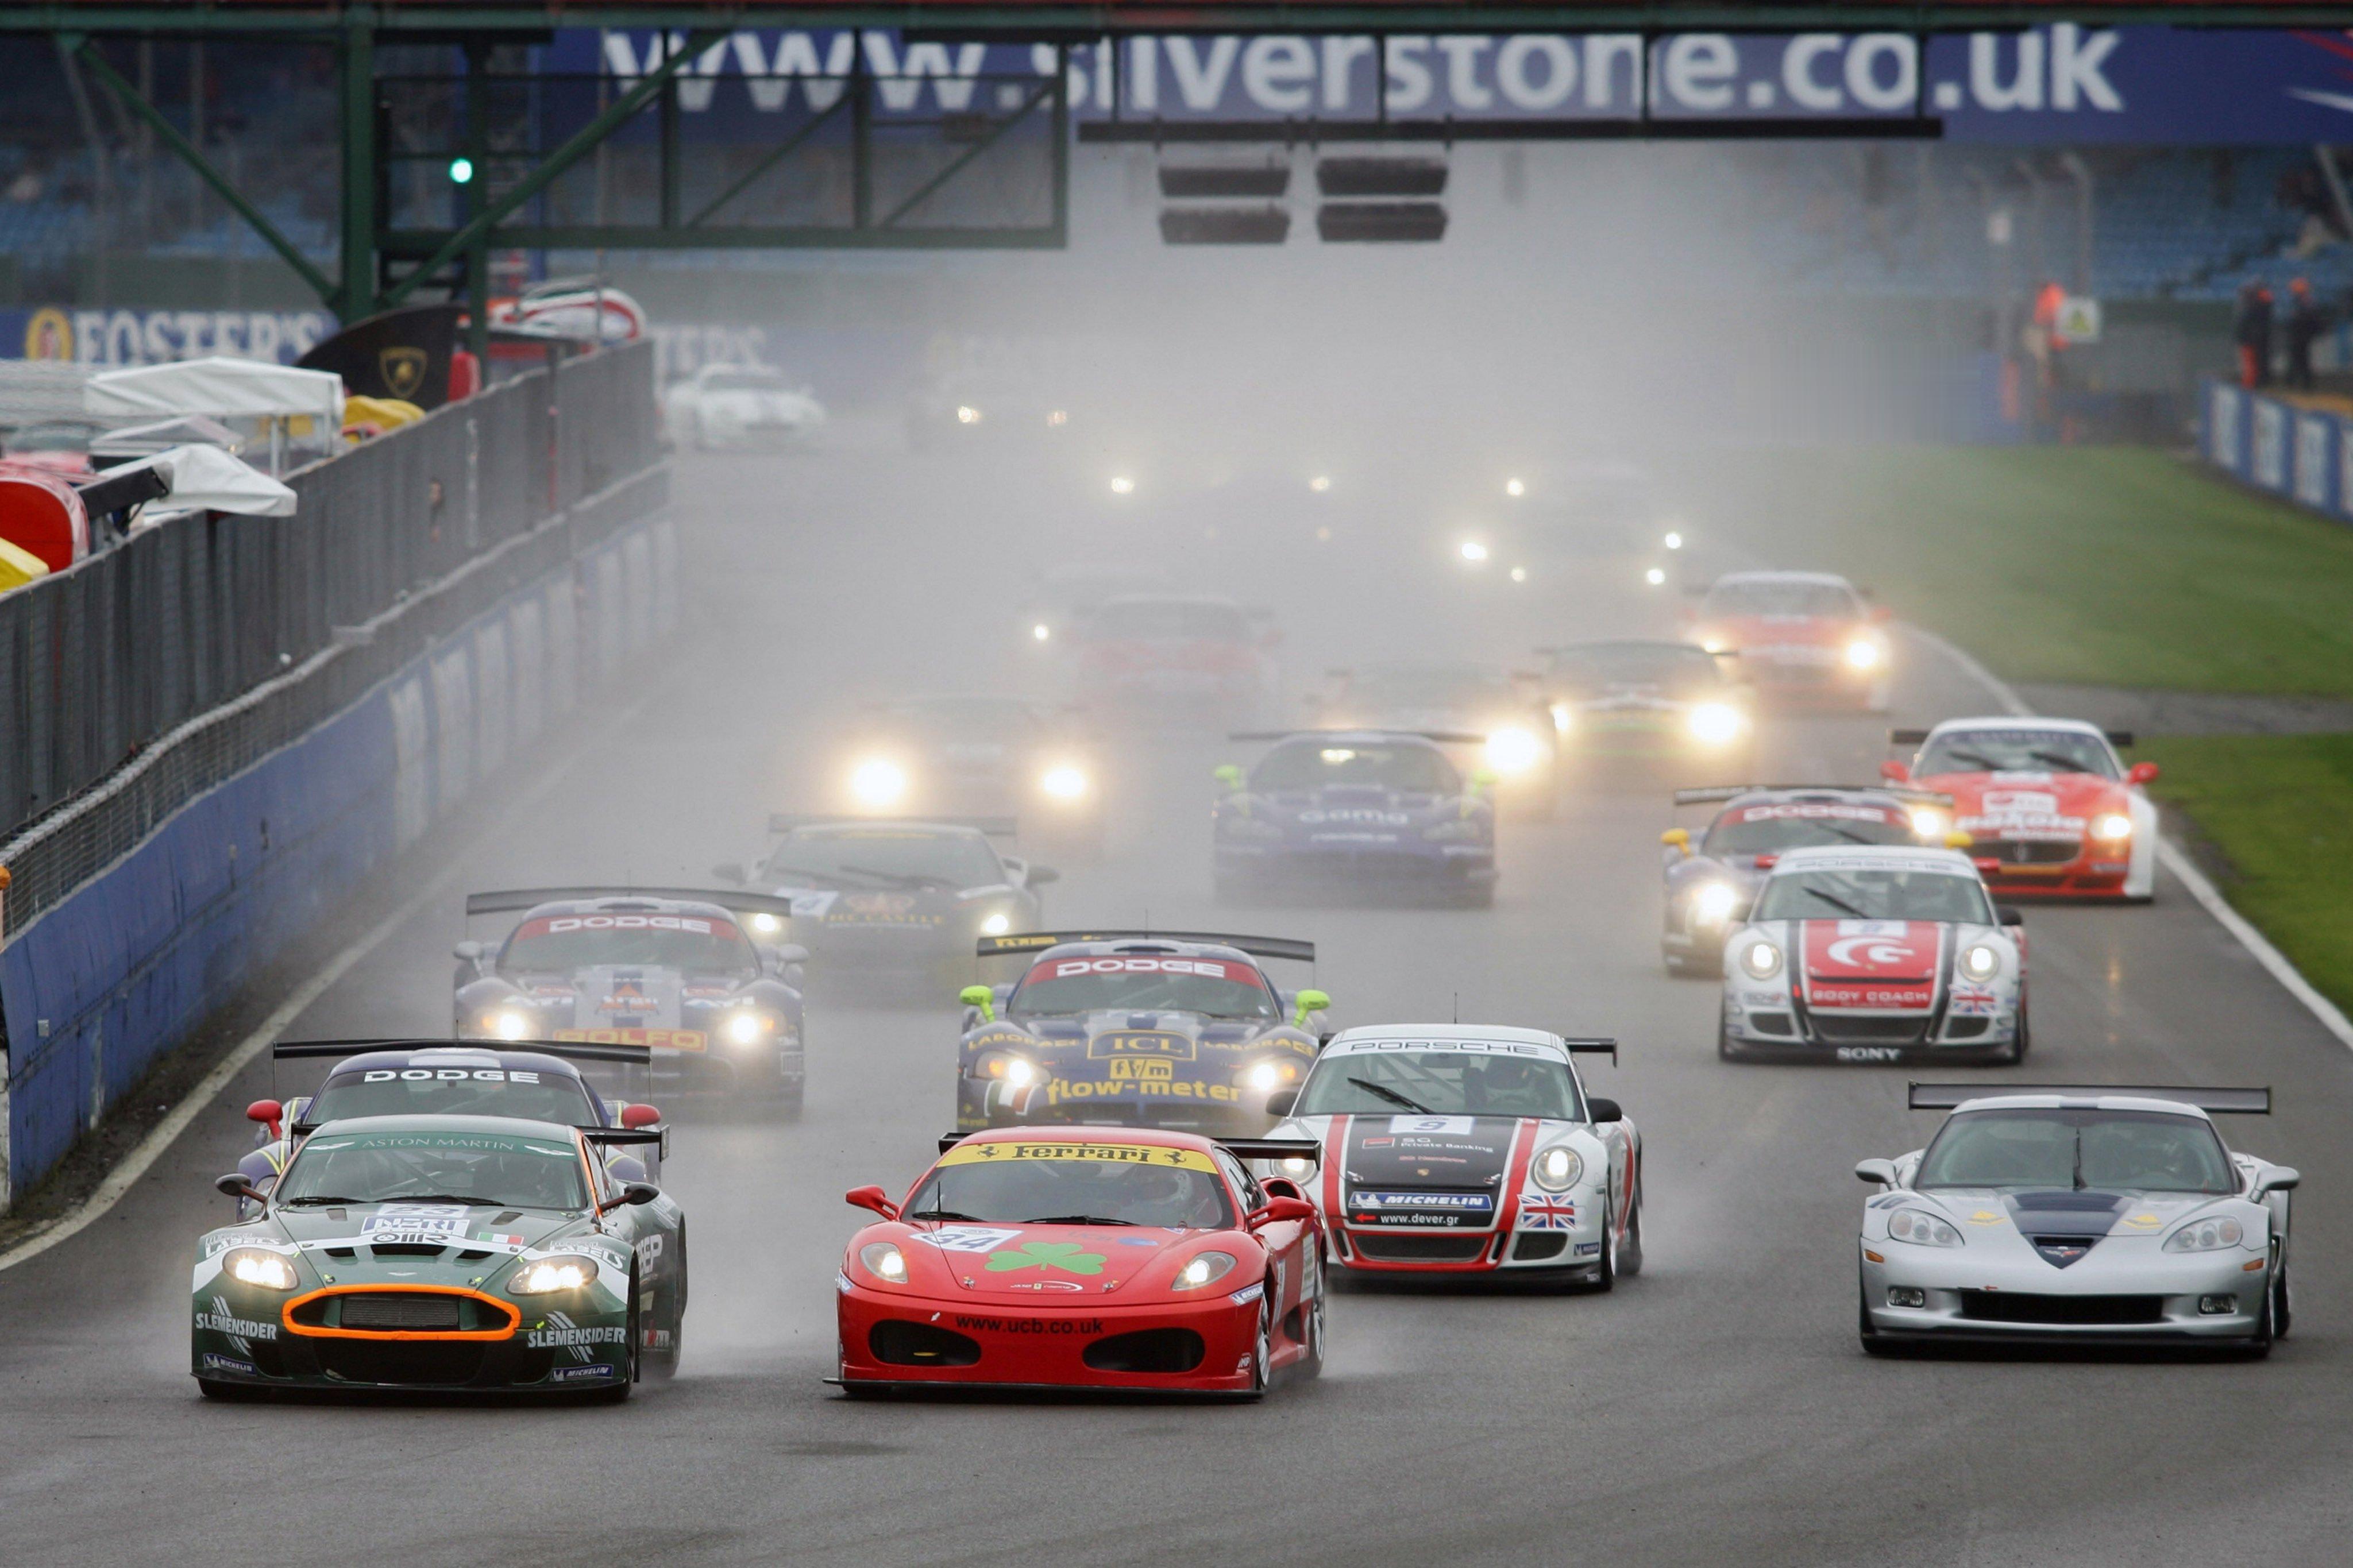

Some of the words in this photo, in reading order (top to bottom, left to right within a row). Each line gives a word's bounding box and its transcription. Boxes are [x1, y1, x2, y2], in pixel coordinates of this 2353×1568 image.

[1743, 805, 1885, 822] DODGE
[549, 916, 711, 934] DODGE
[1056, 959, 1225, 978] DODGE
[1812, 991, 1862, 1001] BODY
[1866, 991, 1930, 1001] COACH
[1350, 1042, 1539, 1056] PORSCHE
[1836, 1046, 1901, 1061] SONY
[364, 1069, 540, 1084] DODGE
[1046, 1077, 1243, 1106] flow-meter
[361, 1138, 430, 1149] ASTON
[437, 1138, 514, 1150] MARTIN
[1445, 1143, 1494, 1153] Banking
[1012, 1145, 1151, 1163] Ferrari
[1385, 1195, 1484, 1206] MICHELIN
[1380, 1213, 1460, 1226] www.dever.gr
[195, 1312, 277, 1340] SLEMENSIDER
[956, 1315, 1104, 1335] www.ucb.co.uk
[527, 1327, 627, 1348] SLEMENSIDER
[220, 1358, 253, 1372] MICHELIN
[566, 1366, 609, 1377] MICHELIN
